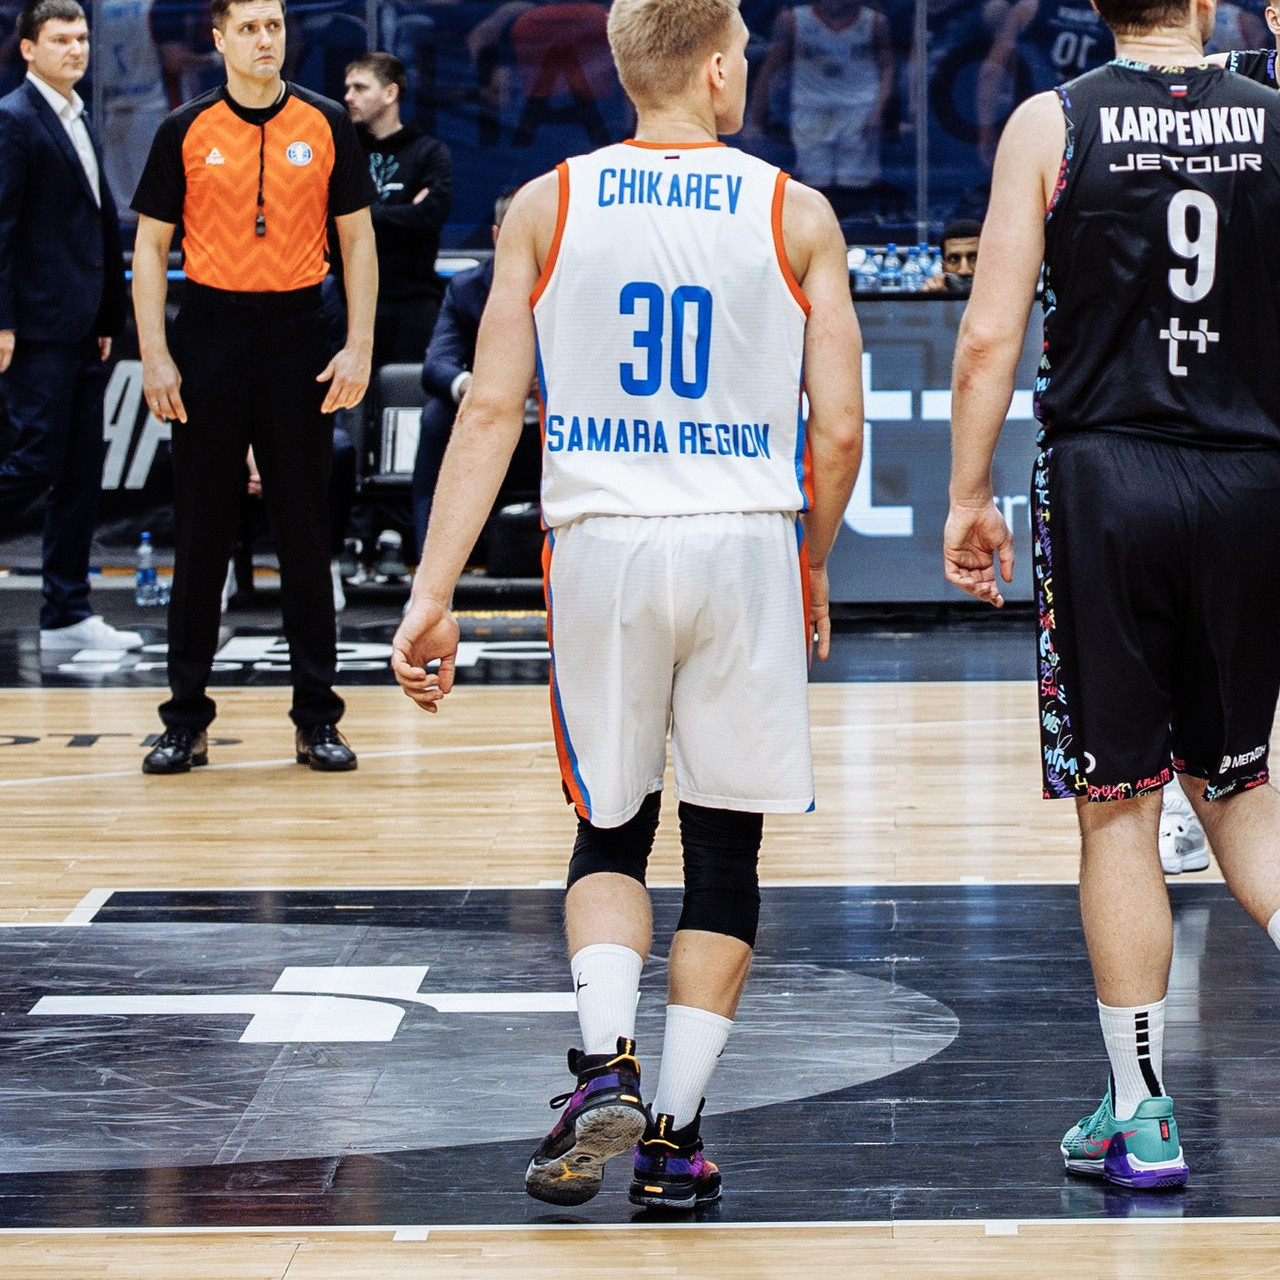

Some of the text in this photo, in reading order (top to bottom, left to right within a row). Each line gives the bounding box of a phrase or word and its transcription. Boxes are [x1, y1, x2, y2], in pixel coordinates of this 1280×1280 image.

[1100, 106, 1265, 146] KARPENKOV
[1109, 153, 1263, 173] JETOUR
[598, 168, 743, 215] CHIKAREV
[1166, 189, 1219, 303] 9
[619, 281, 713, 399] 30
[547, 415, 771, 460] SAMARA REGION
